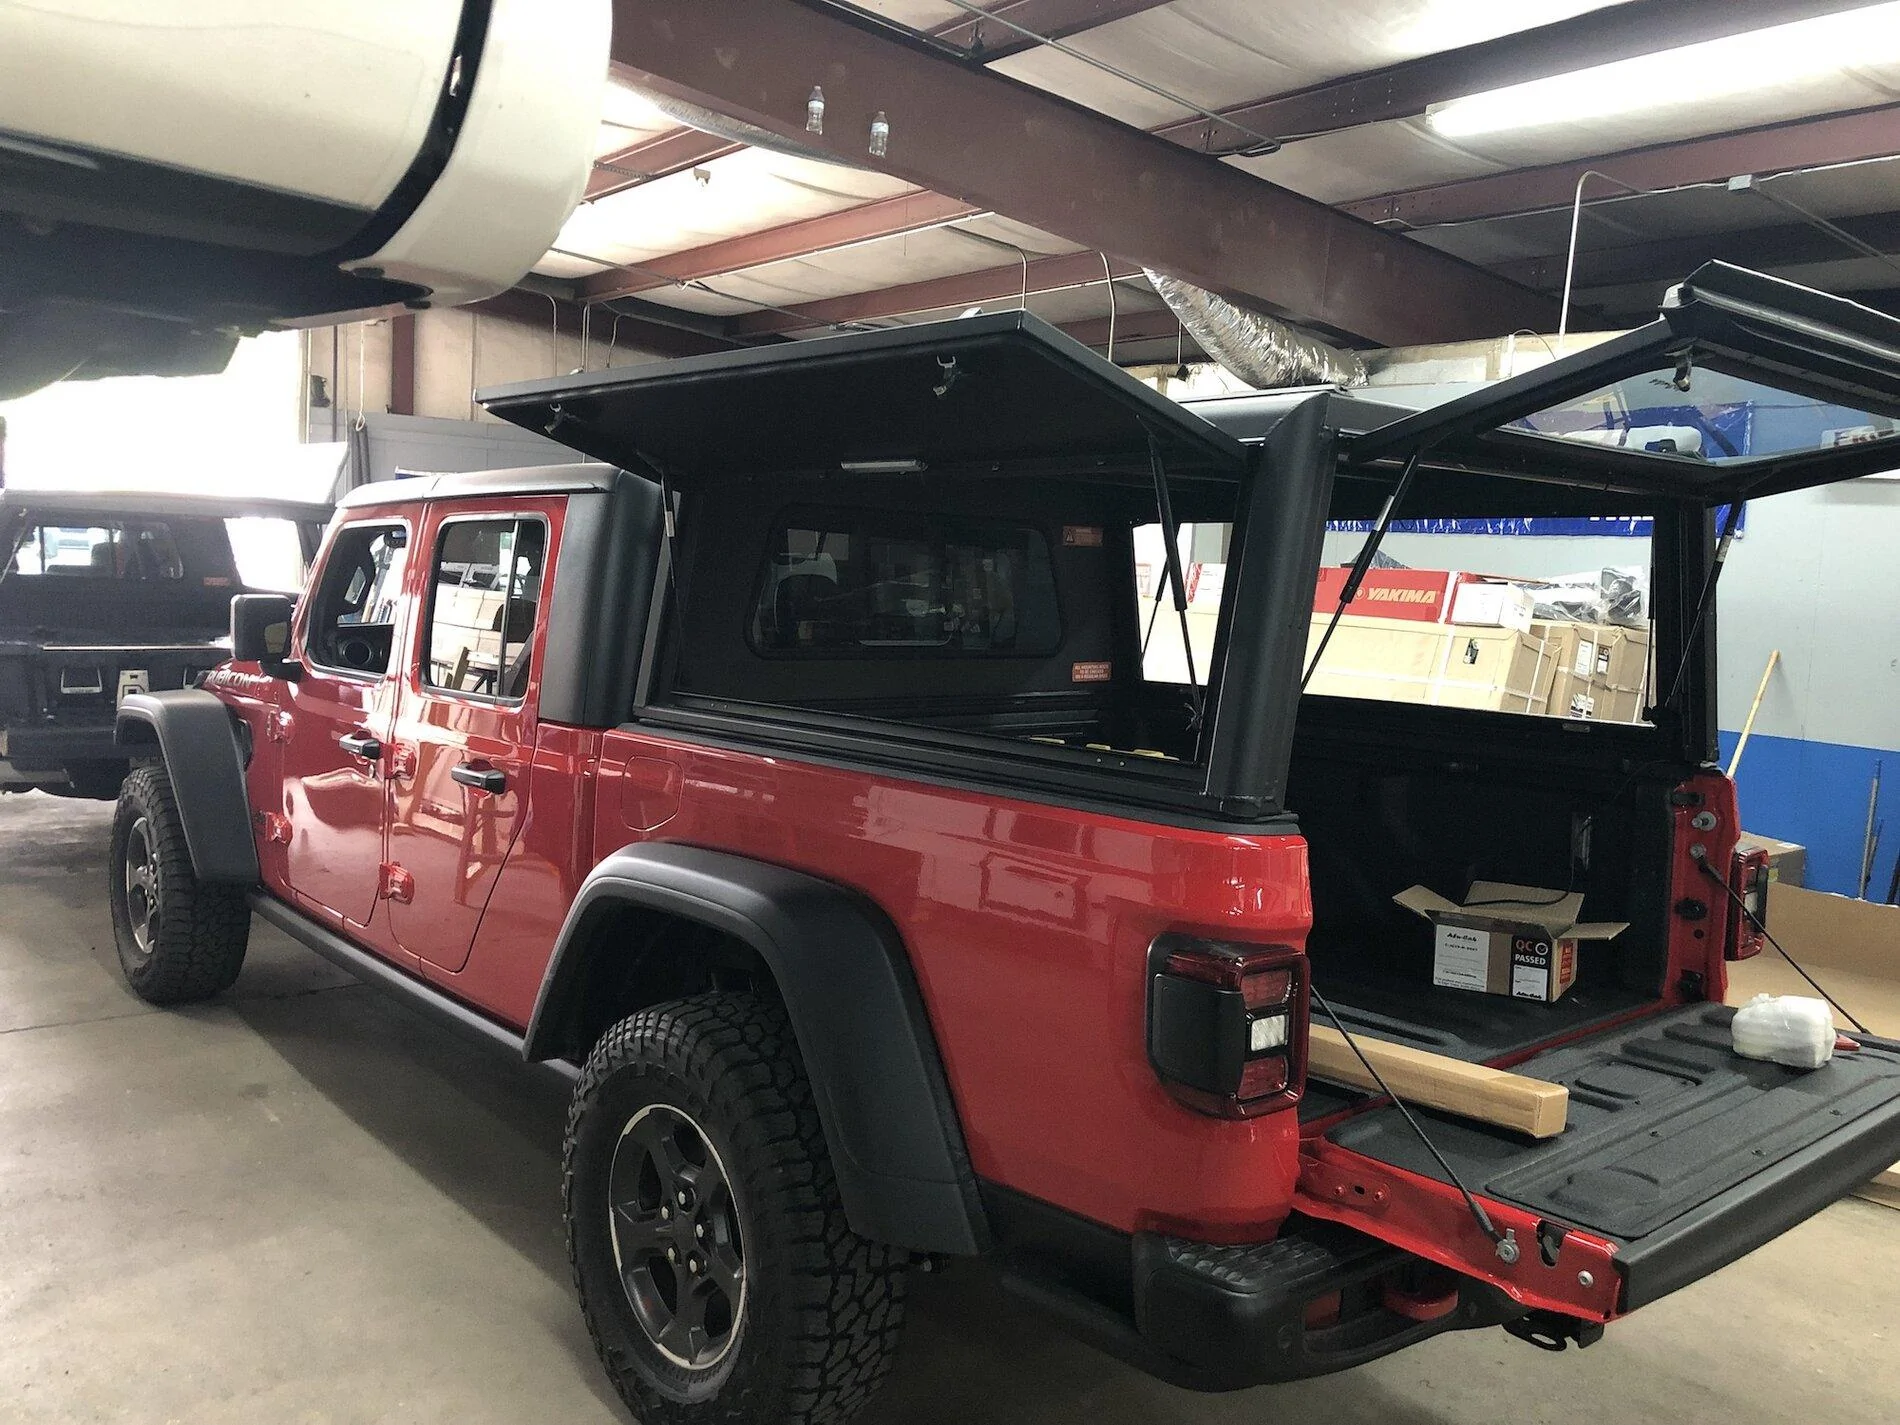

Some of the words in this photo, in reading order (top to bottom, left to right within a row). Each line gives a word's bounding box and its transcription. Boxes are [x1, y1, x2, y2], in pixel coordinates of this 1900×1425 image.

[1367, 588, 1437, 604] YAKIMA
[1515, 939, 1533, 952] QC
[1515, 953, 1546, 966] PASSED
